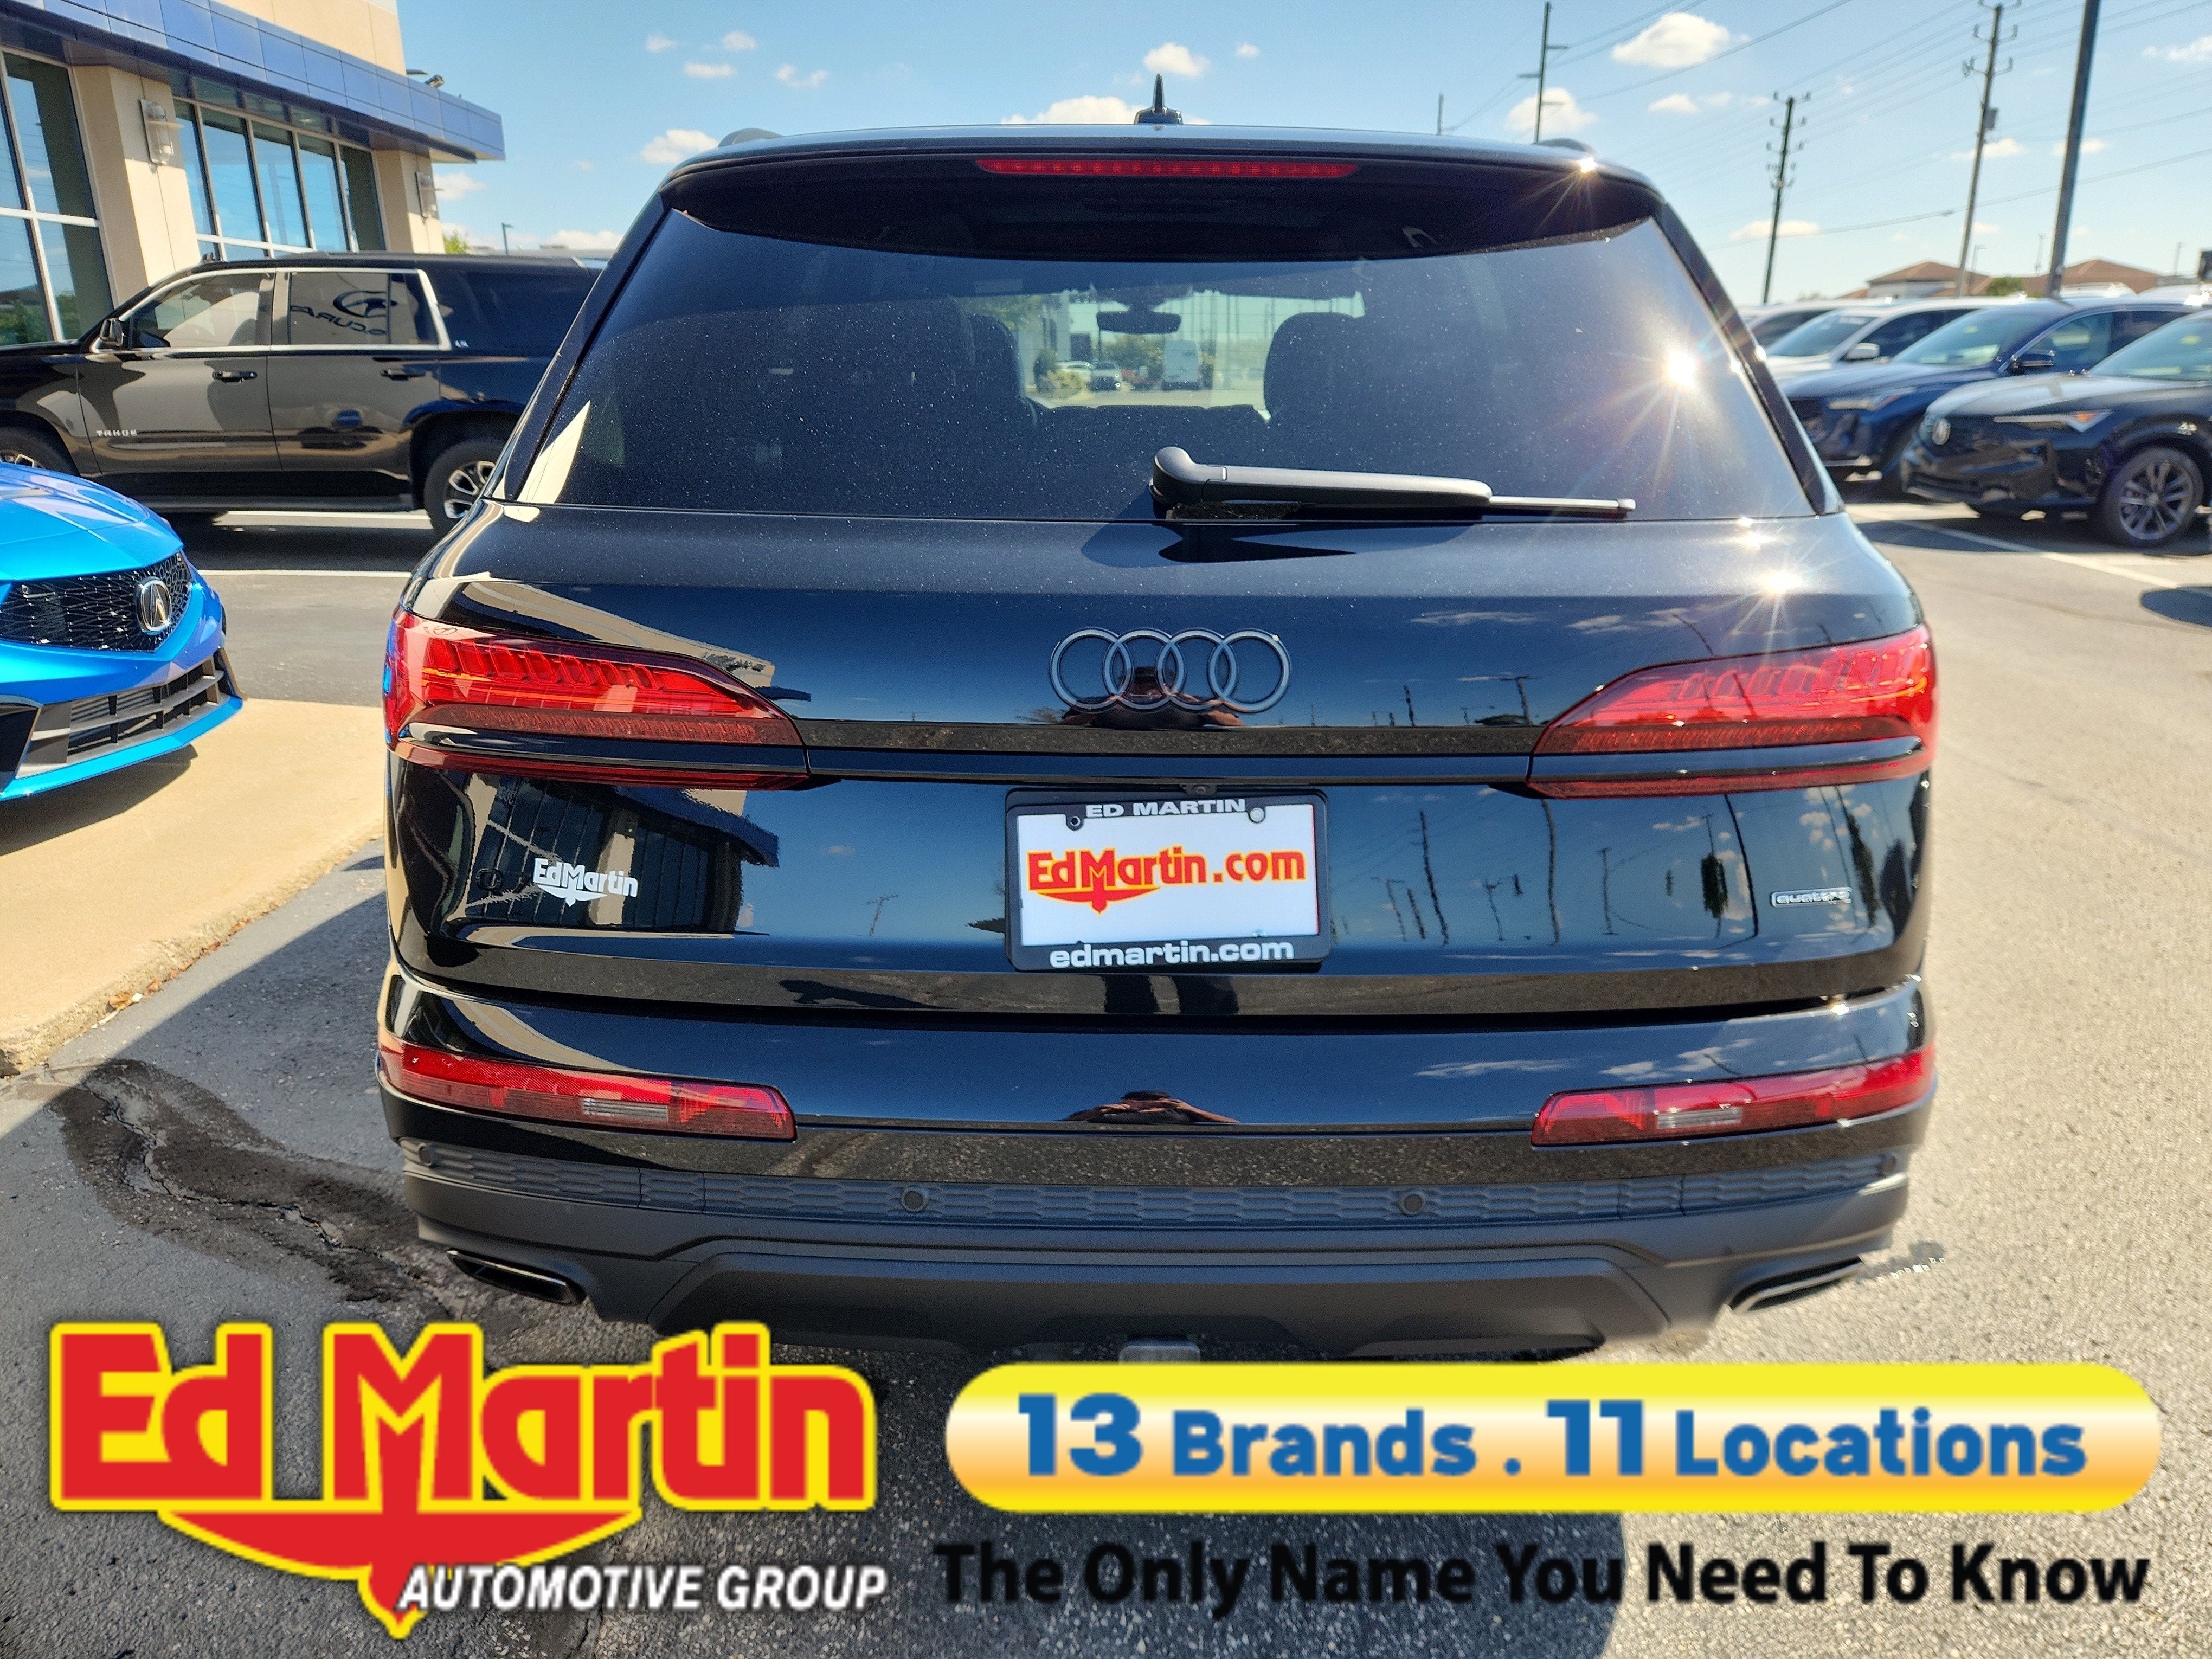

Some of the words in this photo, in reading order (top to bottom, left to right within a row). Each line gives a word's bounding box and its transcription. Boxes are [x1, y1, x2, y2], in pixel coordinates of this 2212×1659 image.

[96, 429, 137, 438] TAHOE
[1085, 804, 1124, 818] ED
[1133, 799, 1246, 816] MARTIN
[1776, 891, 1851, 904] quattro
[1050, 940, 1294, 969] edmartin.com
